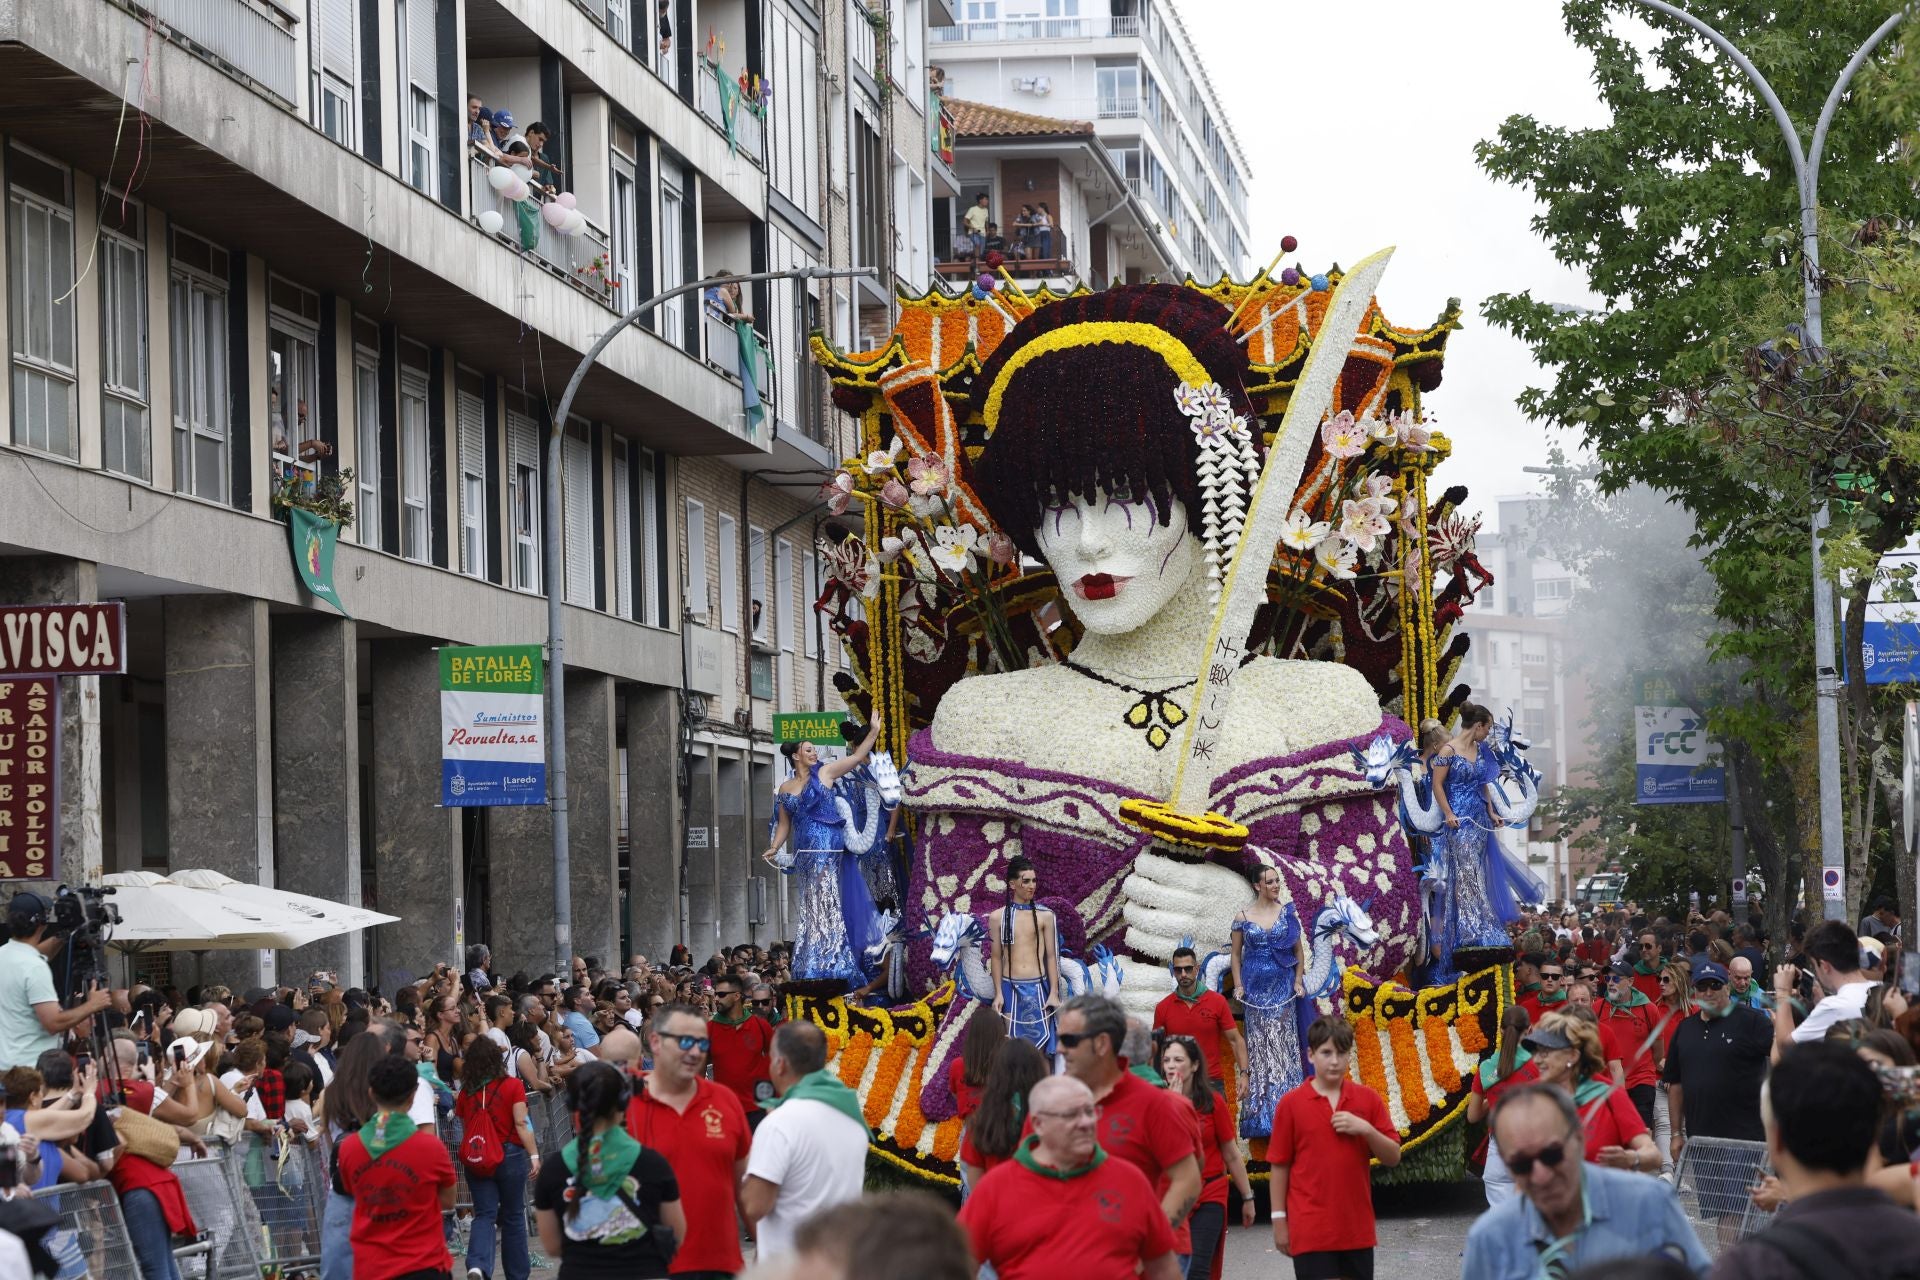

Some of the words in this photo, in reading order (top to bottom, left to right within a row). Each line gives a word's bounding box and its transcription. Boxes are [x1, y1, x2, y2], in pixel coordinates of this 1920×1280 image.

[451, 655, 532, 671] BATALLA
[452, 671, 472, 684] DE
[476, 669, 532, 683] FLORES
[473, 711, 537, 722] Suministros
[26, 682, 48, 774] ASADOR
[781, 719, 838, 730] BATALLA
[782, 730, 795, 739] DE
[799, 729, 838, 738] FLORES
[1648, 730, 1697, 755] FCC
[506, 775, 537, 784] Laredo
[1691, 777, 1718, 785] Laredo
[25, 784, 46, 877] POLLOS
